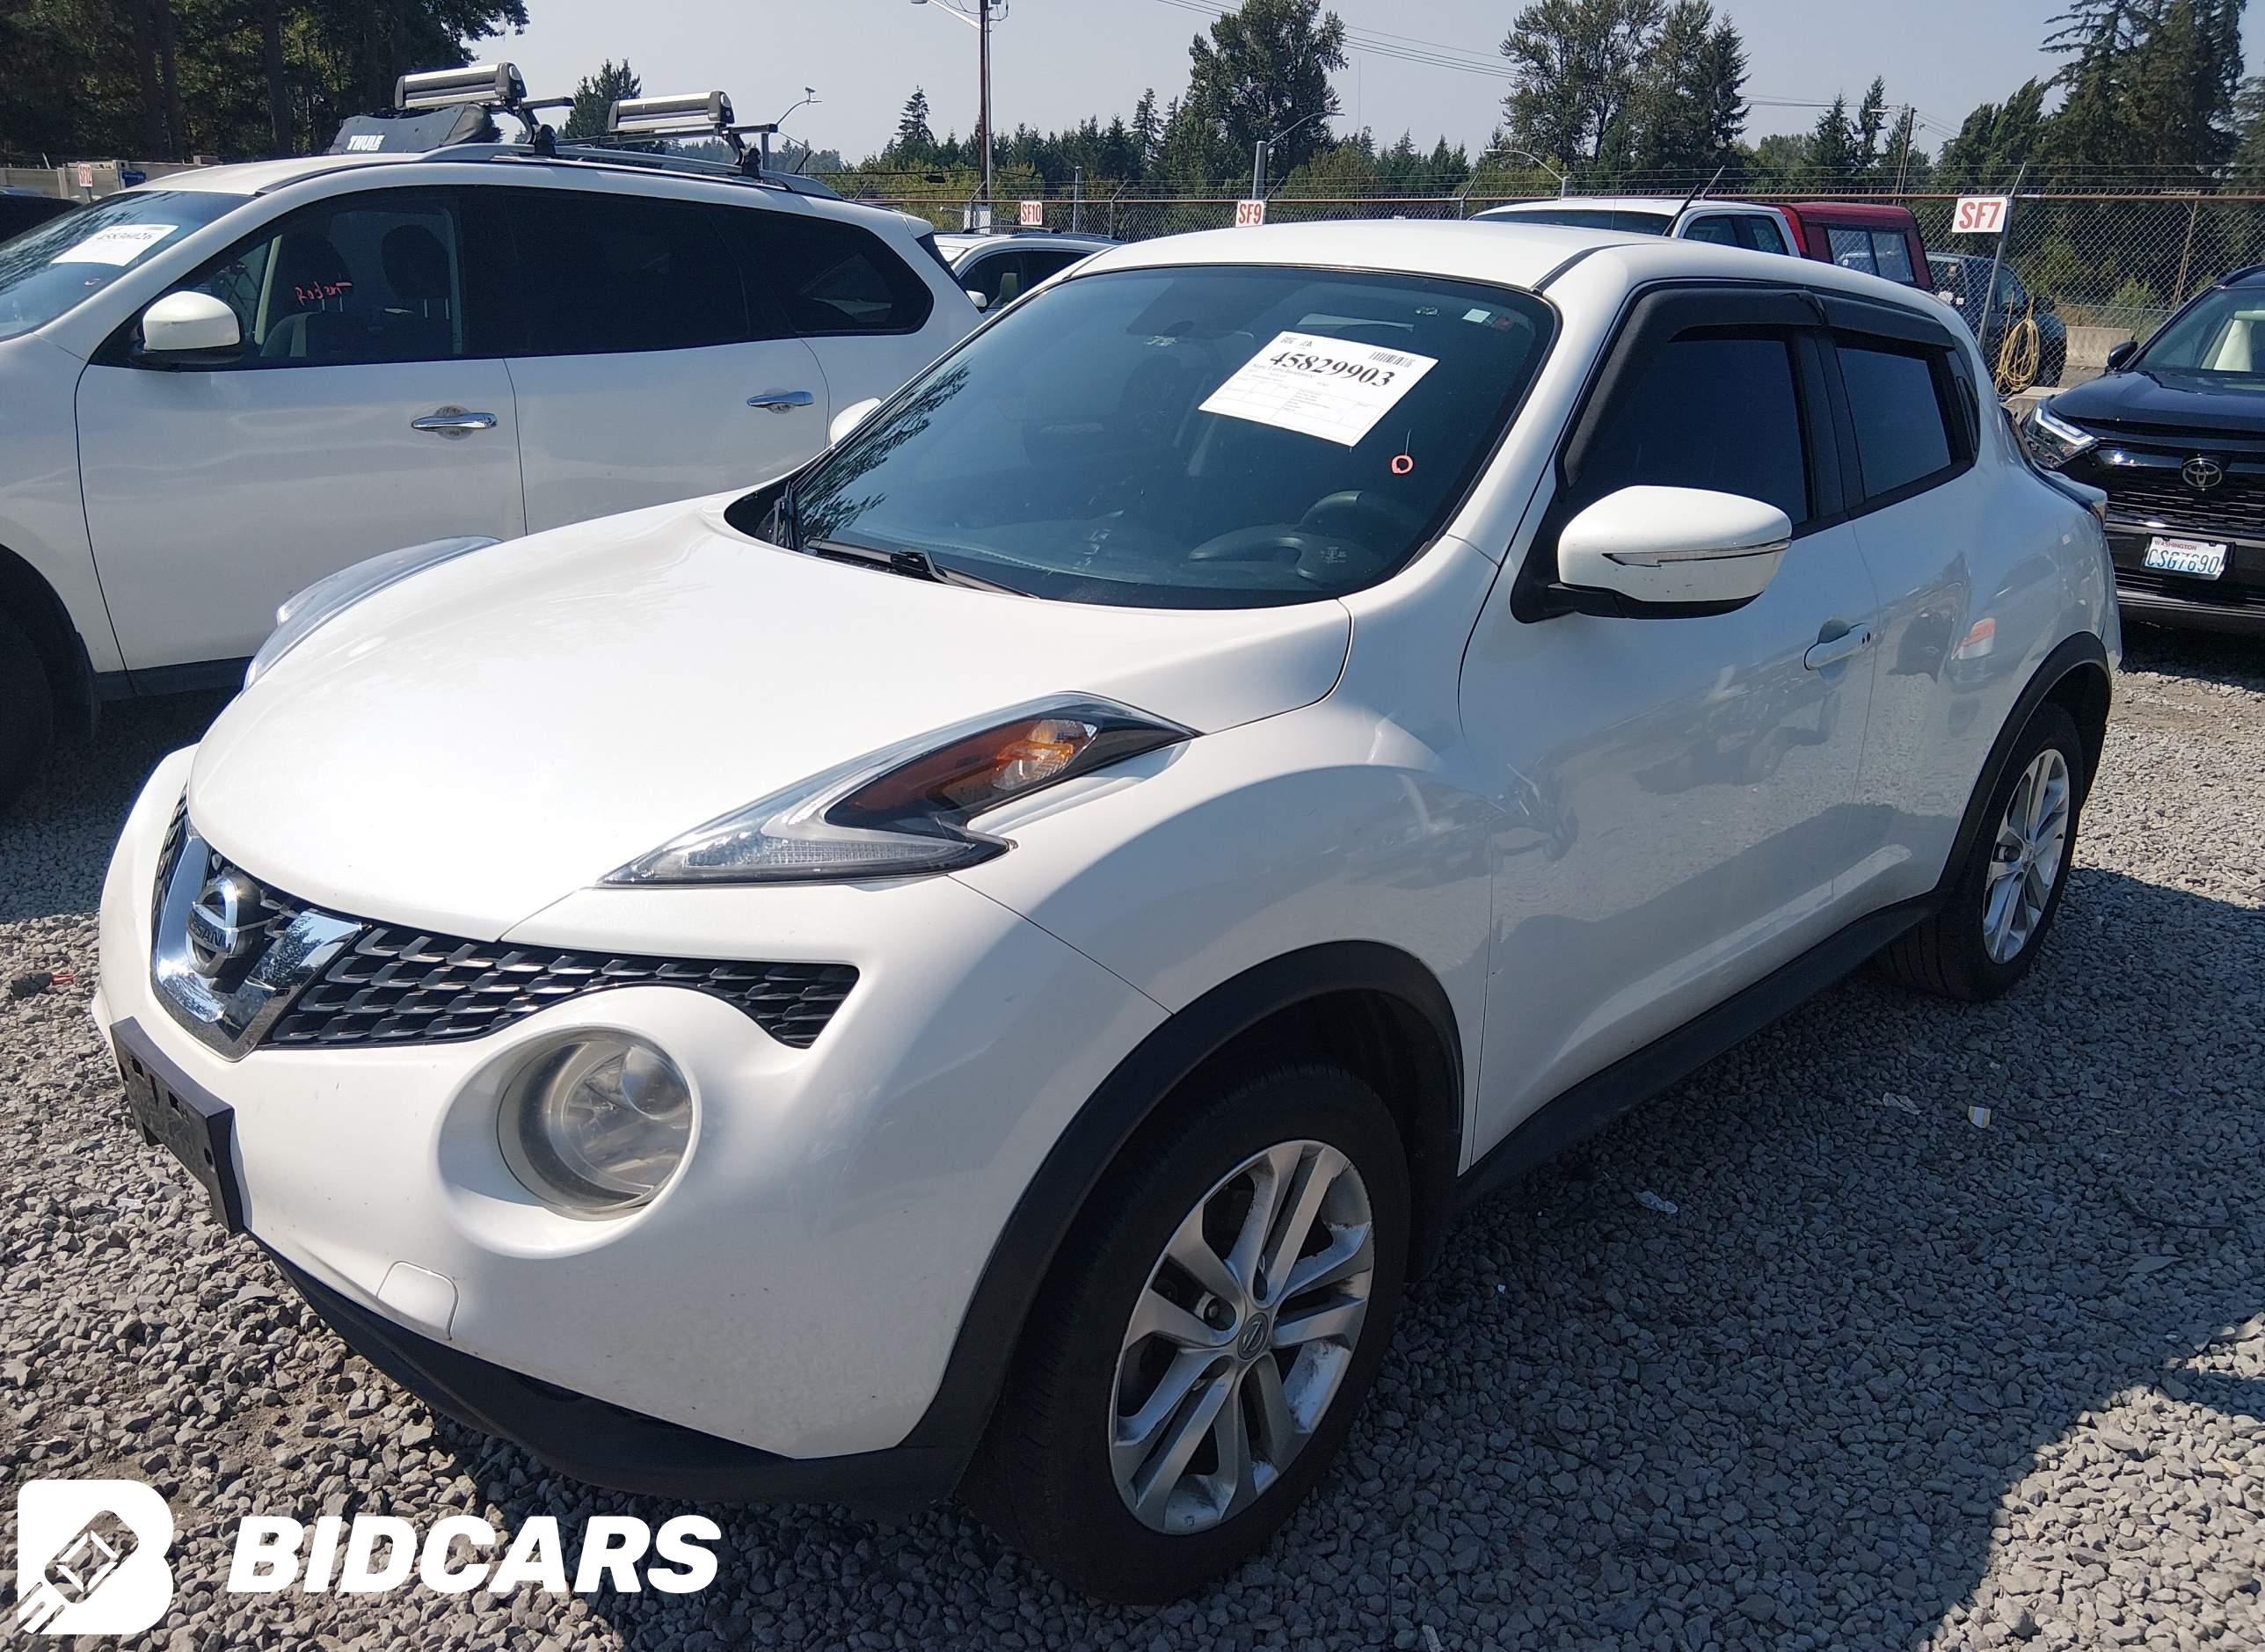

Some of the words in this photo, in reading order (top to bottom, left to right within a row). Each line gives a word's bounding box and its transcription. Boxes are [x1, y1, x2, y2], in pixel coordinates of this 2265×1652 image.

[347, 135, 385, 151] THULE
[1022, 203, 1042, 222] SF10
[1239, 203, 1262, 224] SF9
[1959, 201, 2002, 229] SF7
[1270, 352, 1395, 387] 45829903
[2153, 540, 2197, 550] WASHINGTON
[2147, 549, 2220, 573] CSG7690
